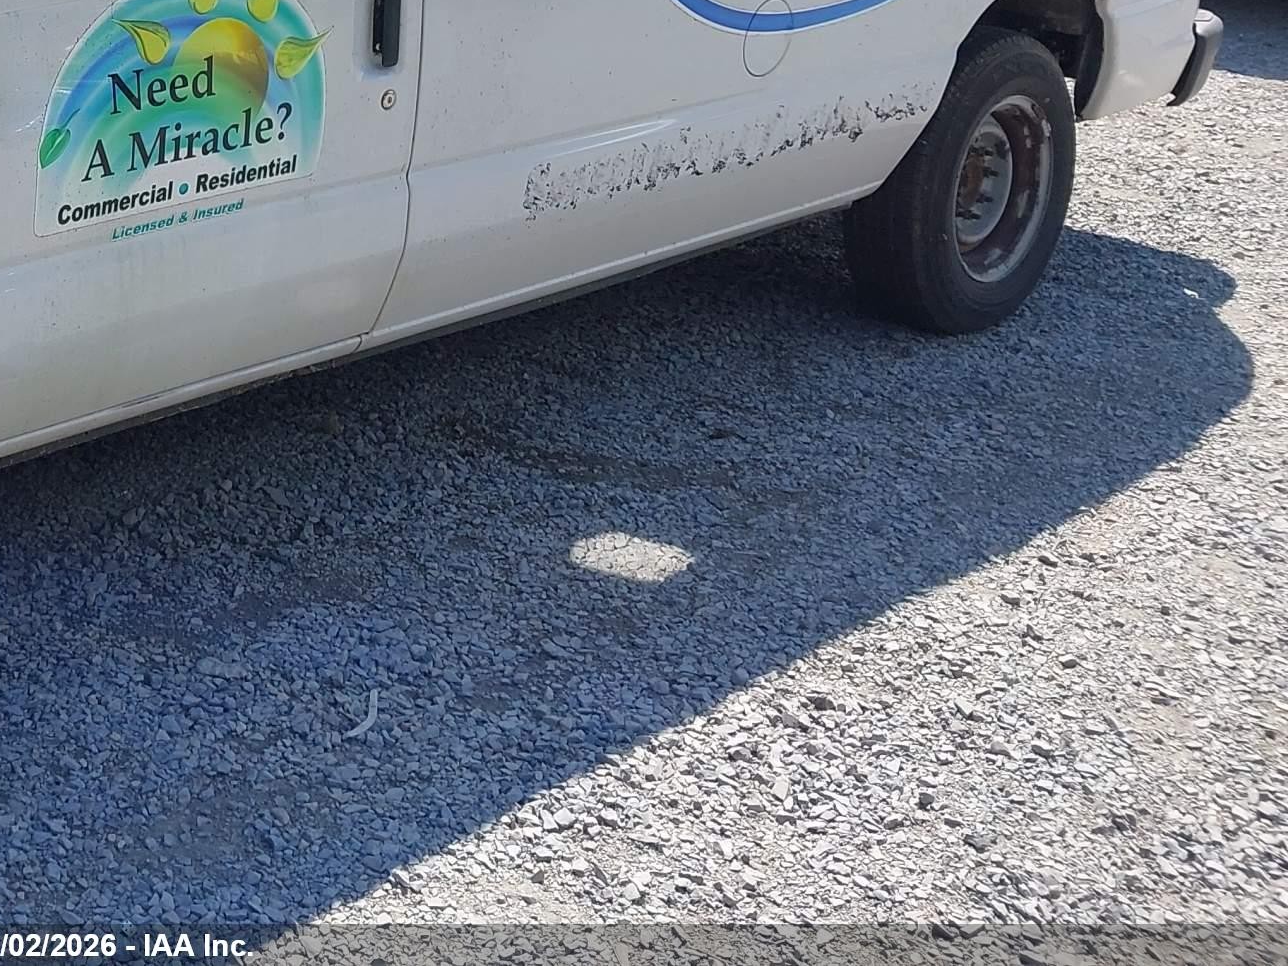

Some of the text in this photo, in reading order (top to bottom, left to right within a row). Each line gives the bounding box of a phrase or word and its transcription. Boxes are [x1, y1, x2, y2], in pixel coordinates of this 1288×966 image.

[107, 55, 217, 116] Need
[81, 102, 293, 183] A Miracle?
[57, 155, 298, 226] Commercial Residential
[111, 198, 246, 240] Licensed & Insured
